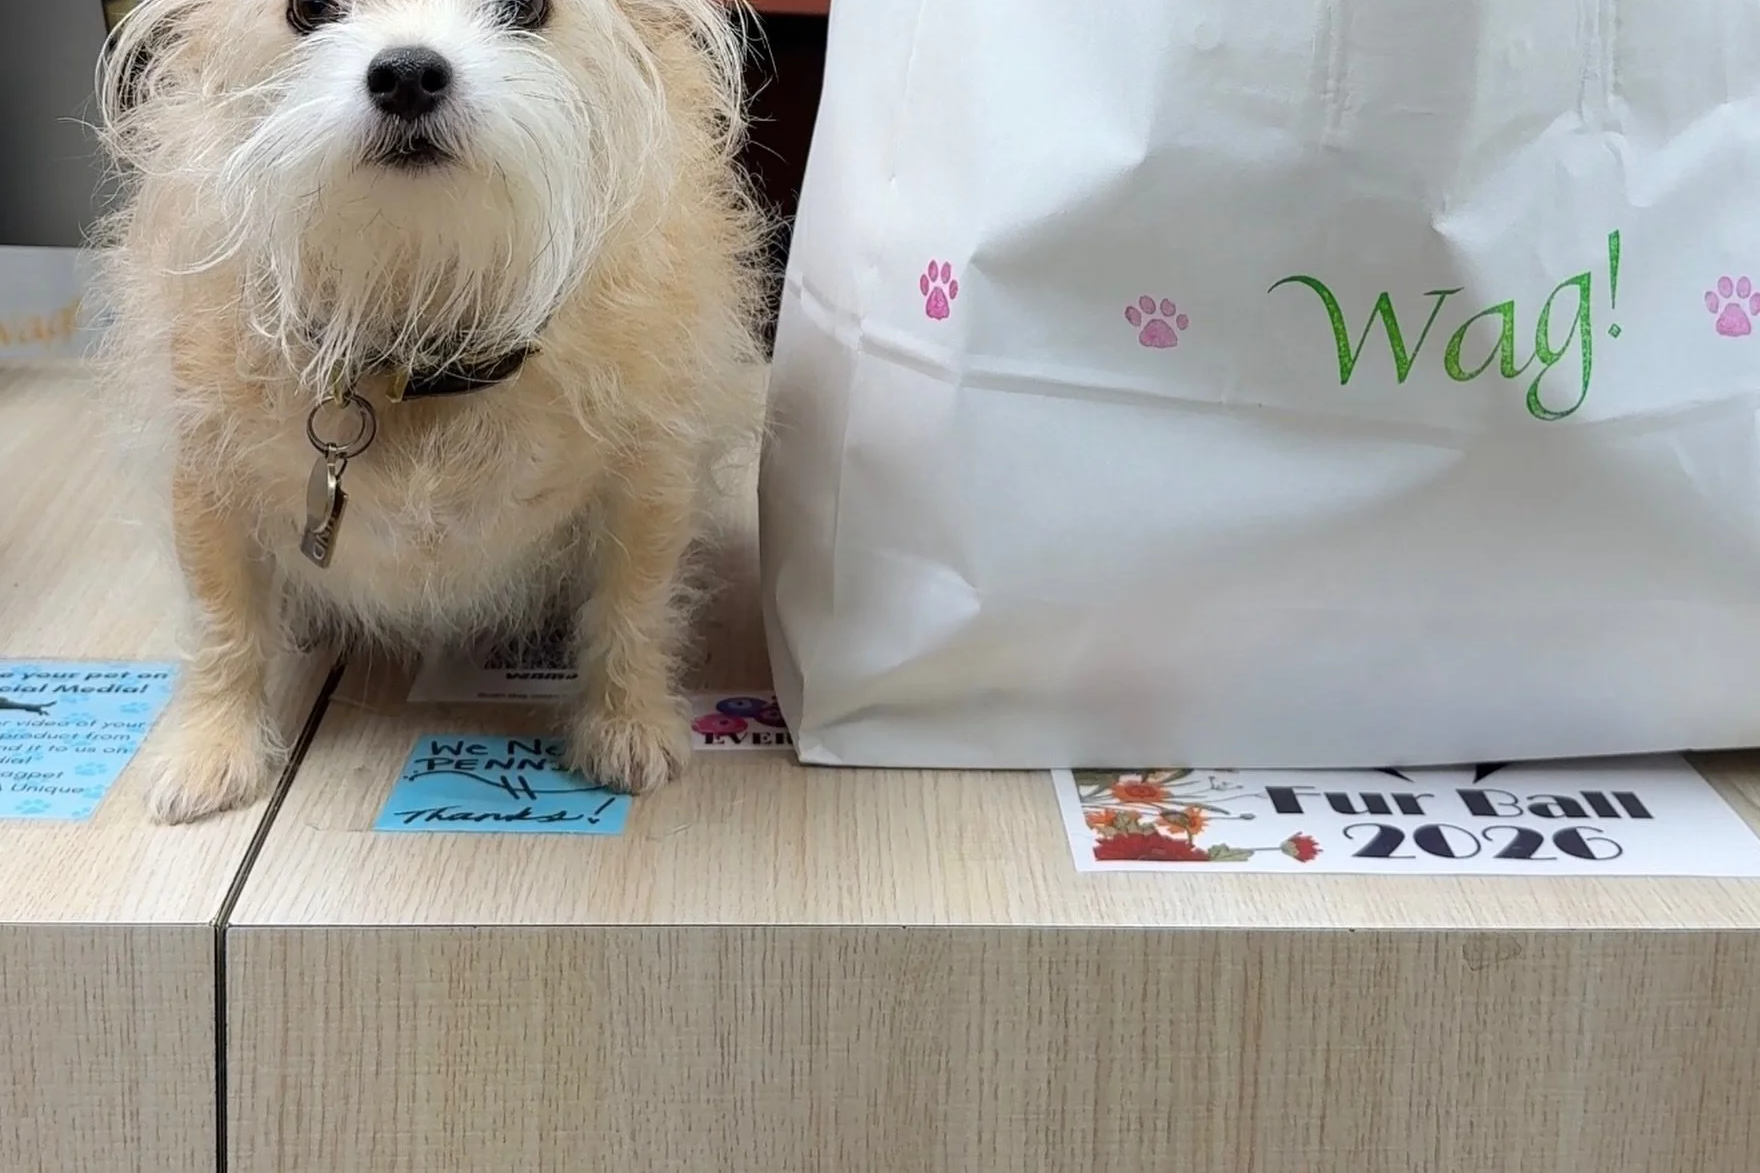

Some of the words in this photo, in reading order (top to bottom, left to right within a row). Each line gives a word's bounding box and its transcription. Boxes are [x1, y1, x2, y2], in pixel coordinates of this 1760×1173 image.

[1267, 229, 1622, 422] Wag!
[21, 672, 81, 681] your
[84, 671, 131, 681] pet
[53, 683, 150, 694] Media!
[16, 719, 70, 727] video
[0, 731, 79, 740] product
[85, 731, 132, 740] from
[25, 744, 45, 753] it
[48, 745, 69, 753] to
[75, 746, 97, 754] us
[431, 739, 488, 756] We
[11, 783, 85, 795] Unique
[1265, 785, 1435, 816] Fur
[1455, 788, 1655, 819] Ball
[1343, 822, 1624, 862] 2026
